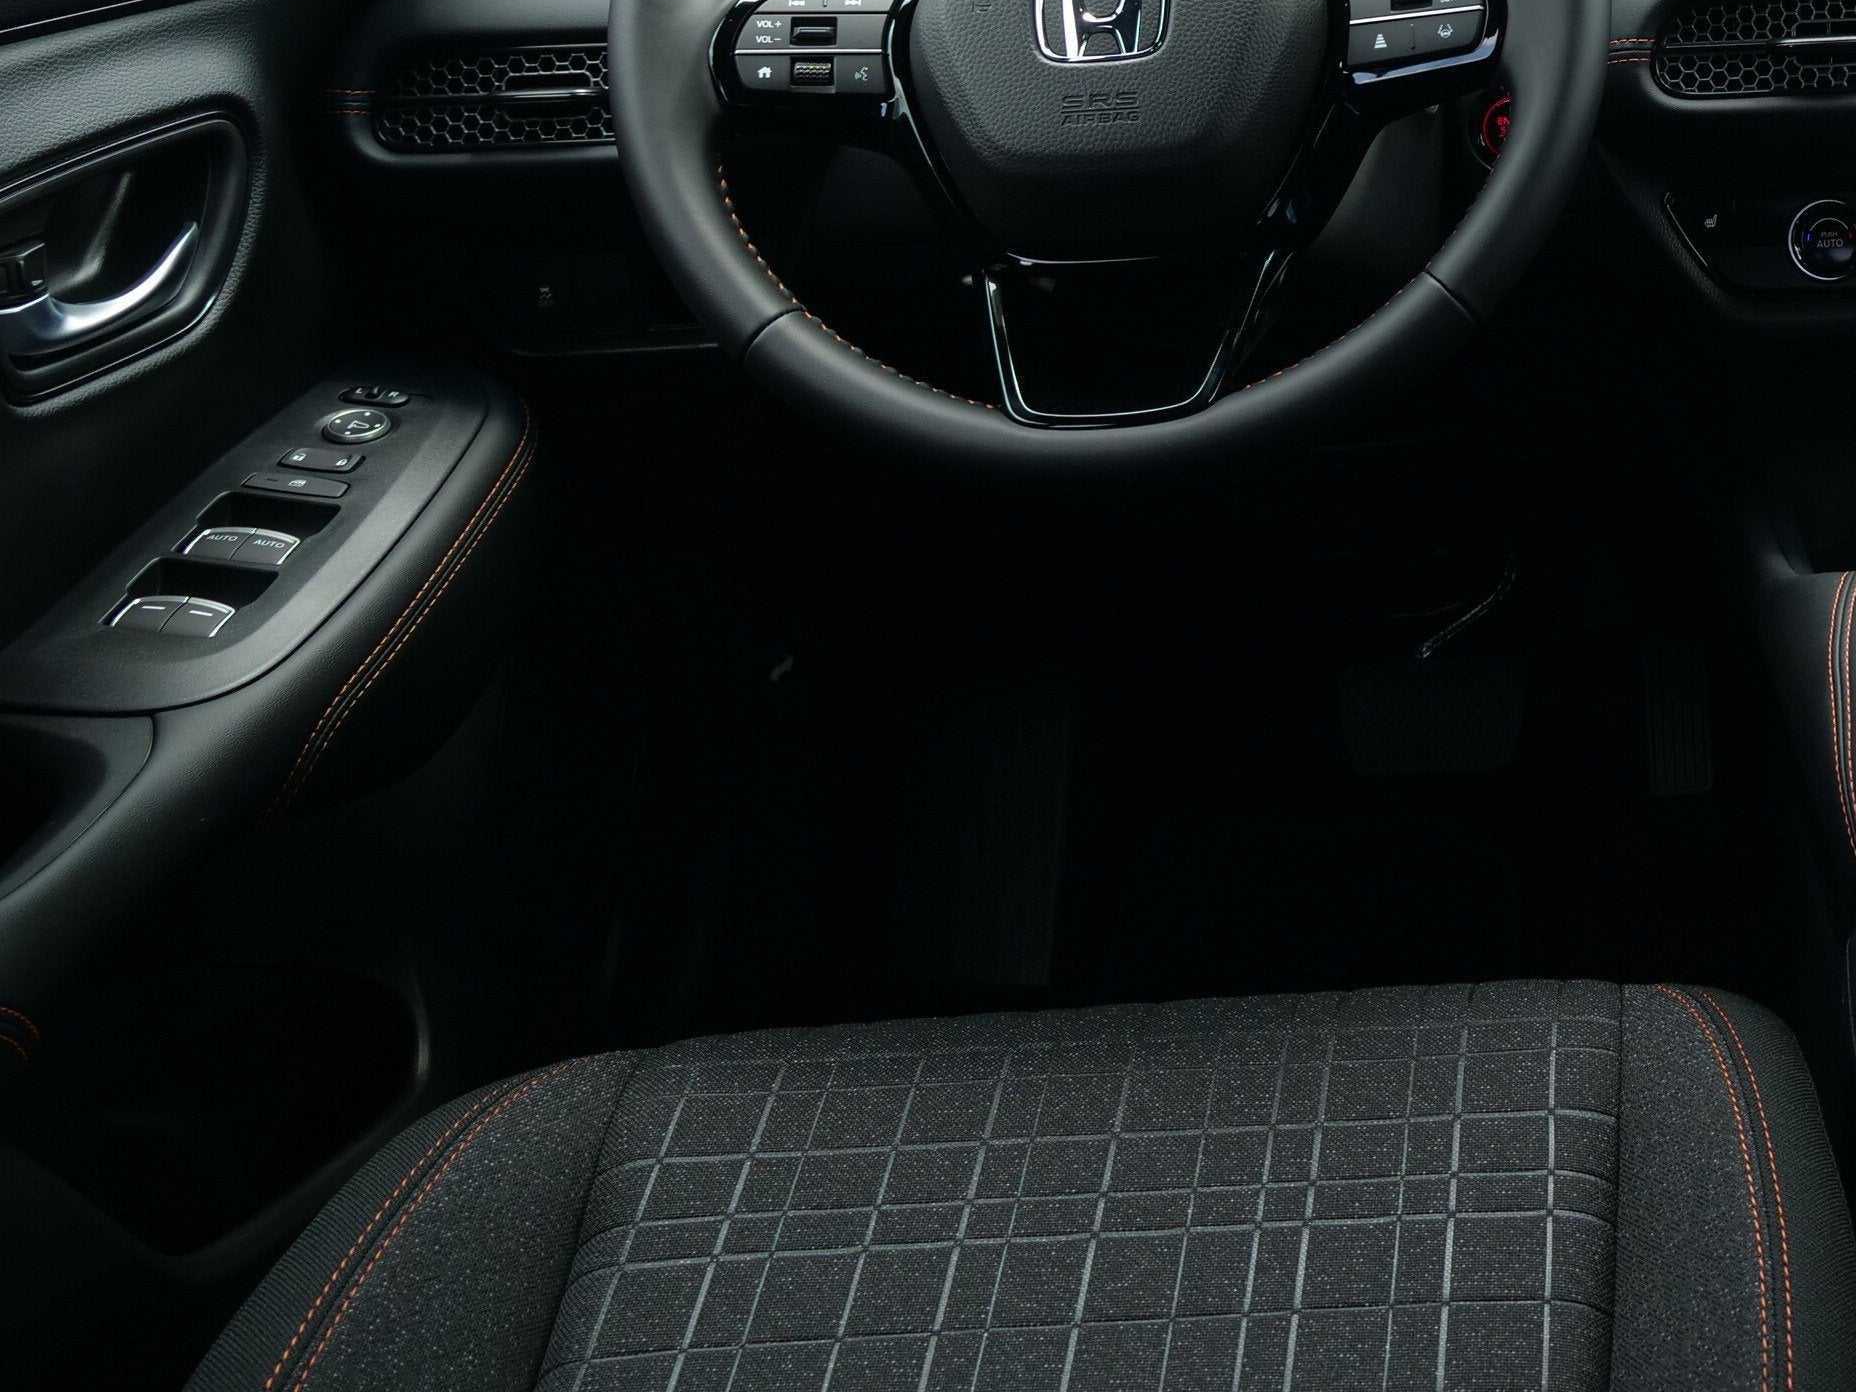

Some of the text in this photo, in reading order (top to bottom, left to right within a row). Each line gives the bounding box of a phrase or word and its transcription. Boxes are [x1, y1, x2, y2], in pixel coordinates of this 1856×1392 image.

[1062, 91, 1140, 108] SRS
[1061, 111, 1140, 126] AIRBAG
[1816, 238, 1844, 248] AUTO
[207, 534, 285, 549] AUTO AUTO
